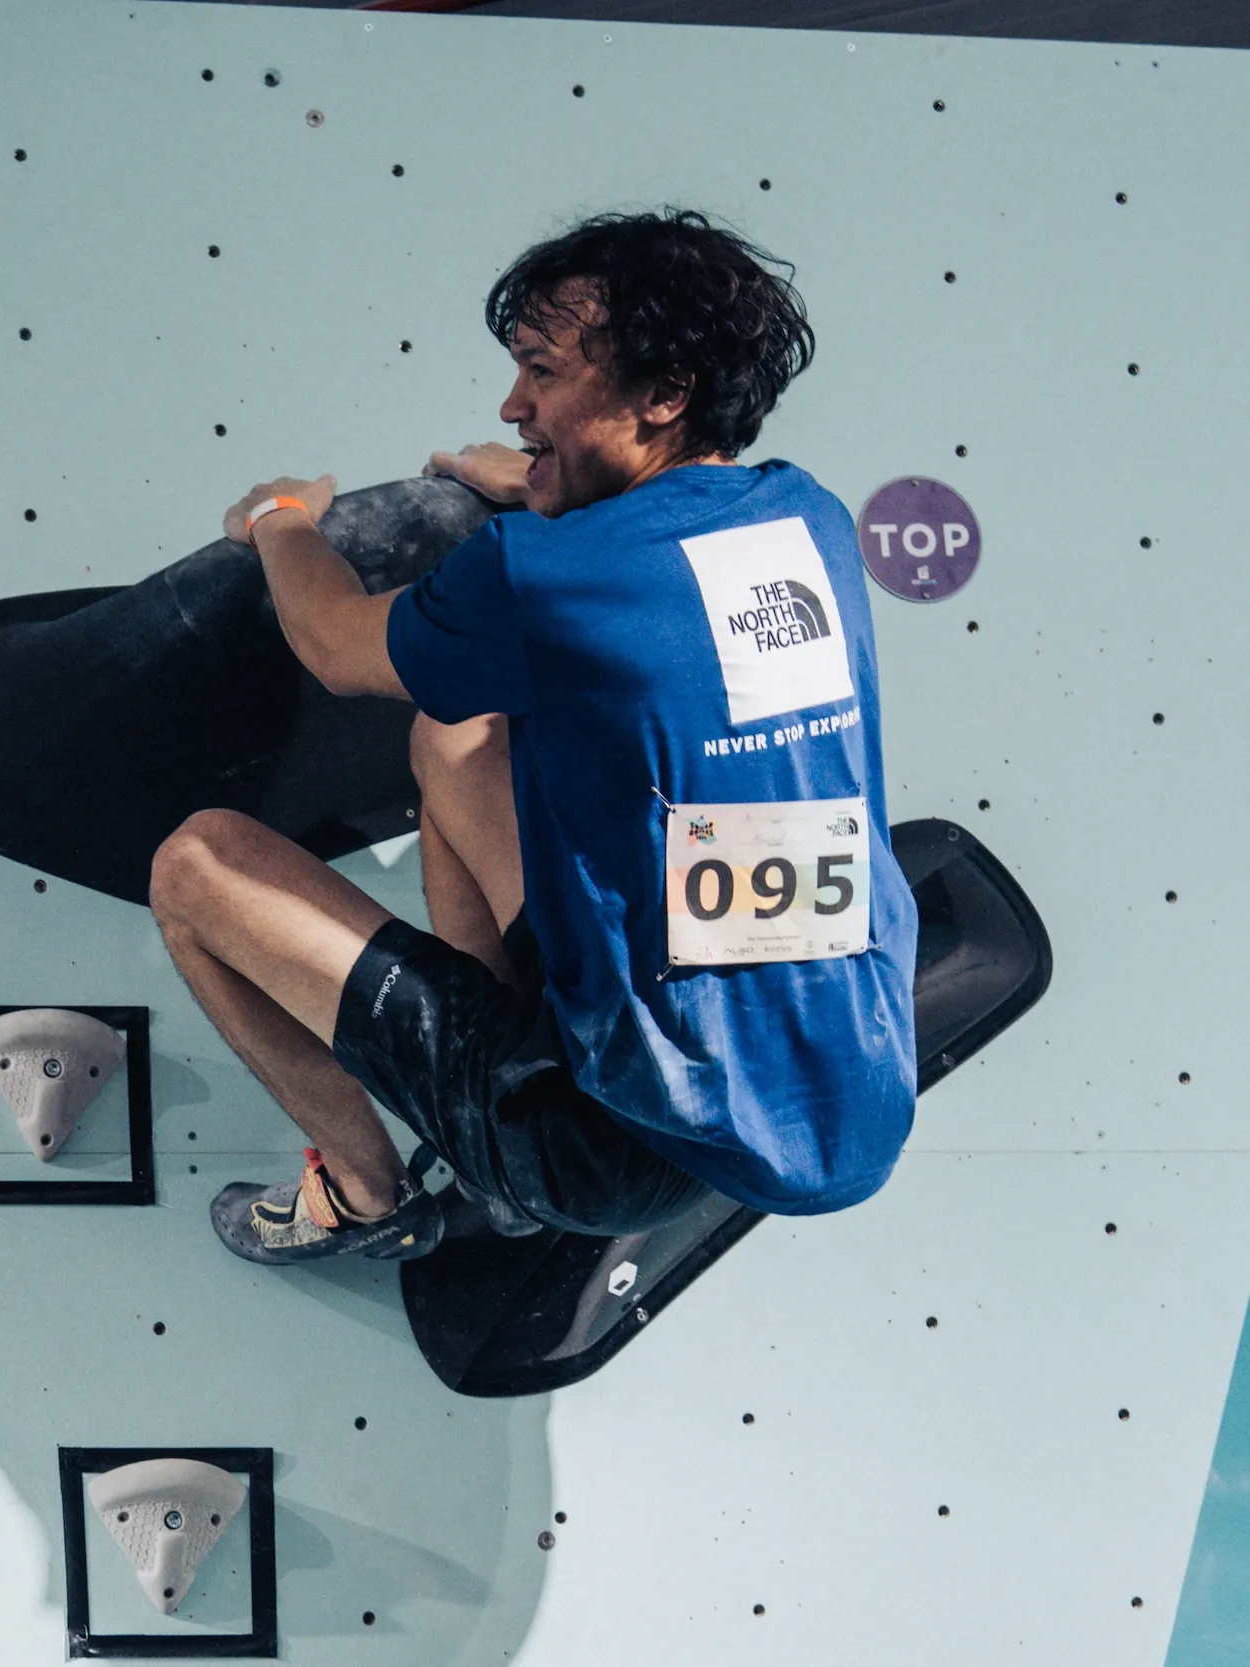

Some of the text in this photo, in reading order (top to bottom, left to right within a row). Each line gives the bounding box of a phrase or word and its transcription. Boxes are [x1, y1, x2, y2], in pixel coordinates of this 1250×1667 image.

[869, 522, 970, 558] TOP
[750, 581, 789, 606] THE
[728, 602, 796, 636] NORTH
[754, 624, 802, 653] FACE
[704, 732, 768, 757] NEVER
[773, 723, 806, 747] STOP
[685, 853, 854, 921] 095
